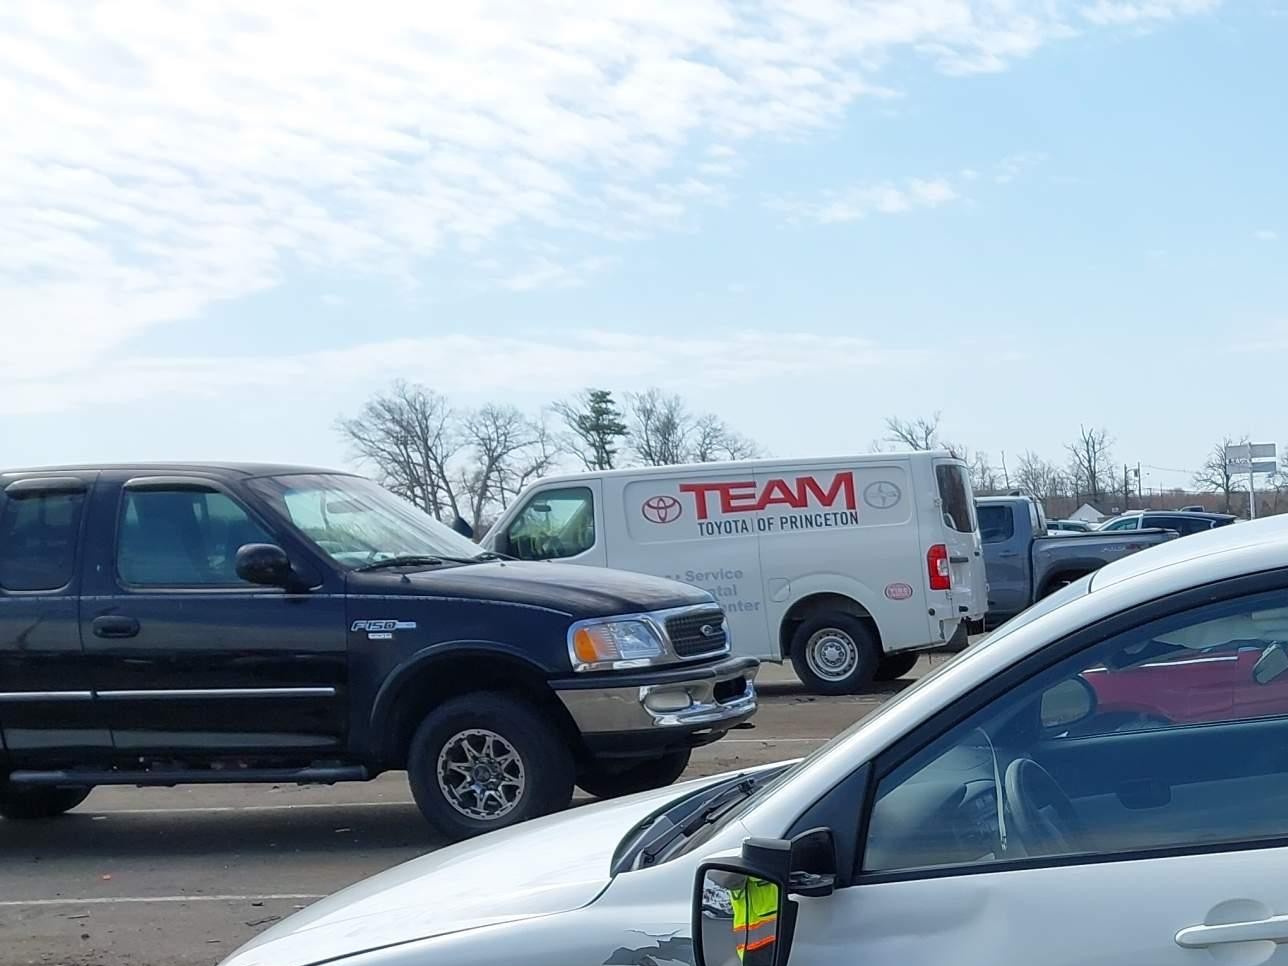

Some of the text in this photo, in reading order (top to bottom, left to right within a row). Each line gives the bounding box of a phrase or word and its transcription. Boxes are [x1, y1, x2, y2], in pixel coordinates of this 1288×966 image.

[679, 471, 857, 520] TEAM
[697, 511, 860, 537] TOYOTA OF PRINCETON
[685, 567, 744, 582] Service
